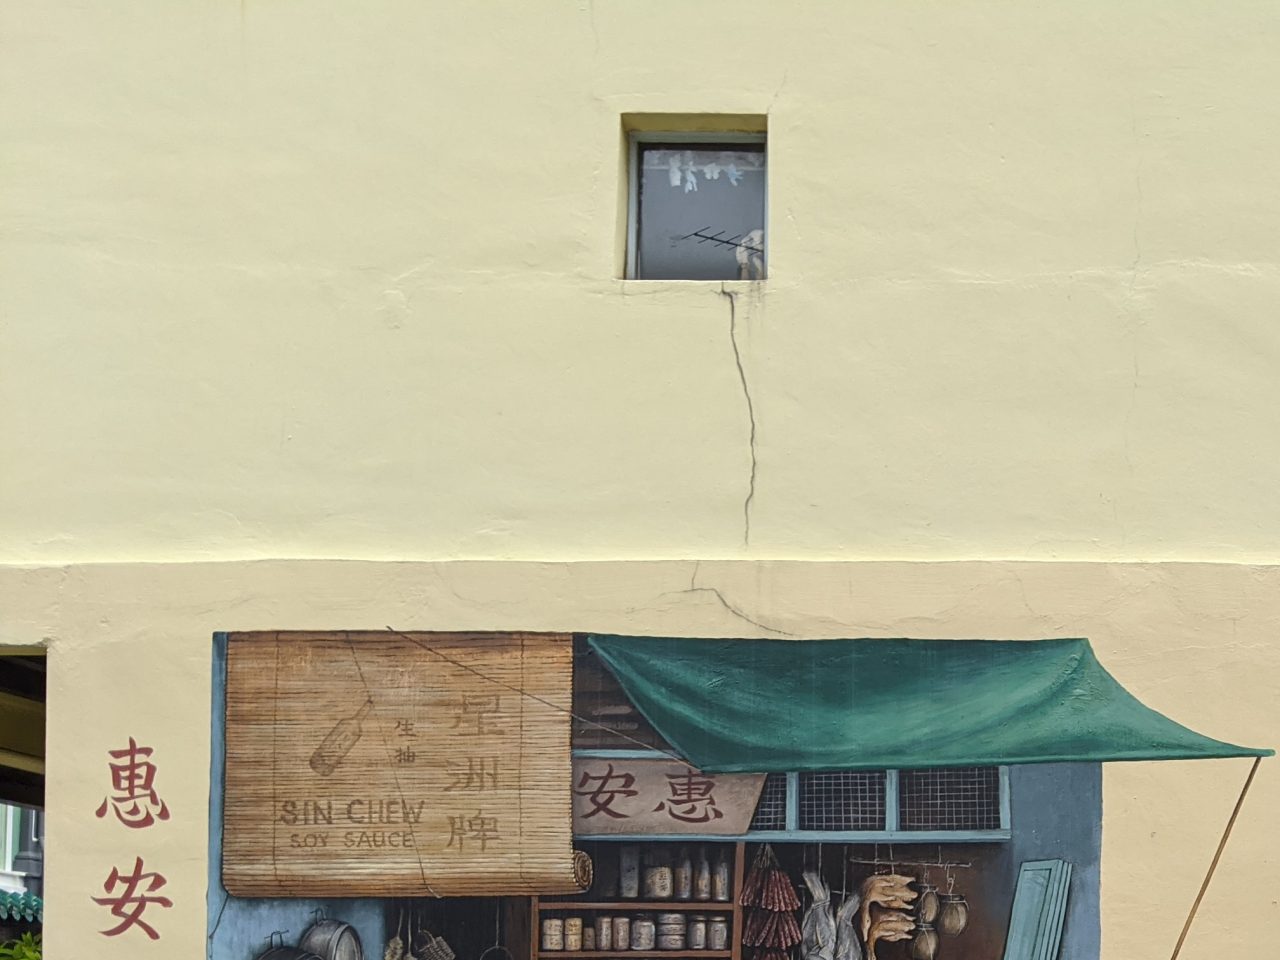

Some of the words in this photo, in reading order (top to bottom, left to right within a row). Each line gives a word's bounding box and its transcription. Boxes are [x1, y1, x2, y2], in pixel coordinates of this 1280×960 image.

[280, 799, 333, 825] SIN
[346, 799, 425, 825] CHEW
[290, 832, 329, 848] SOY
[344, 832, 413, 848] SAUCE
